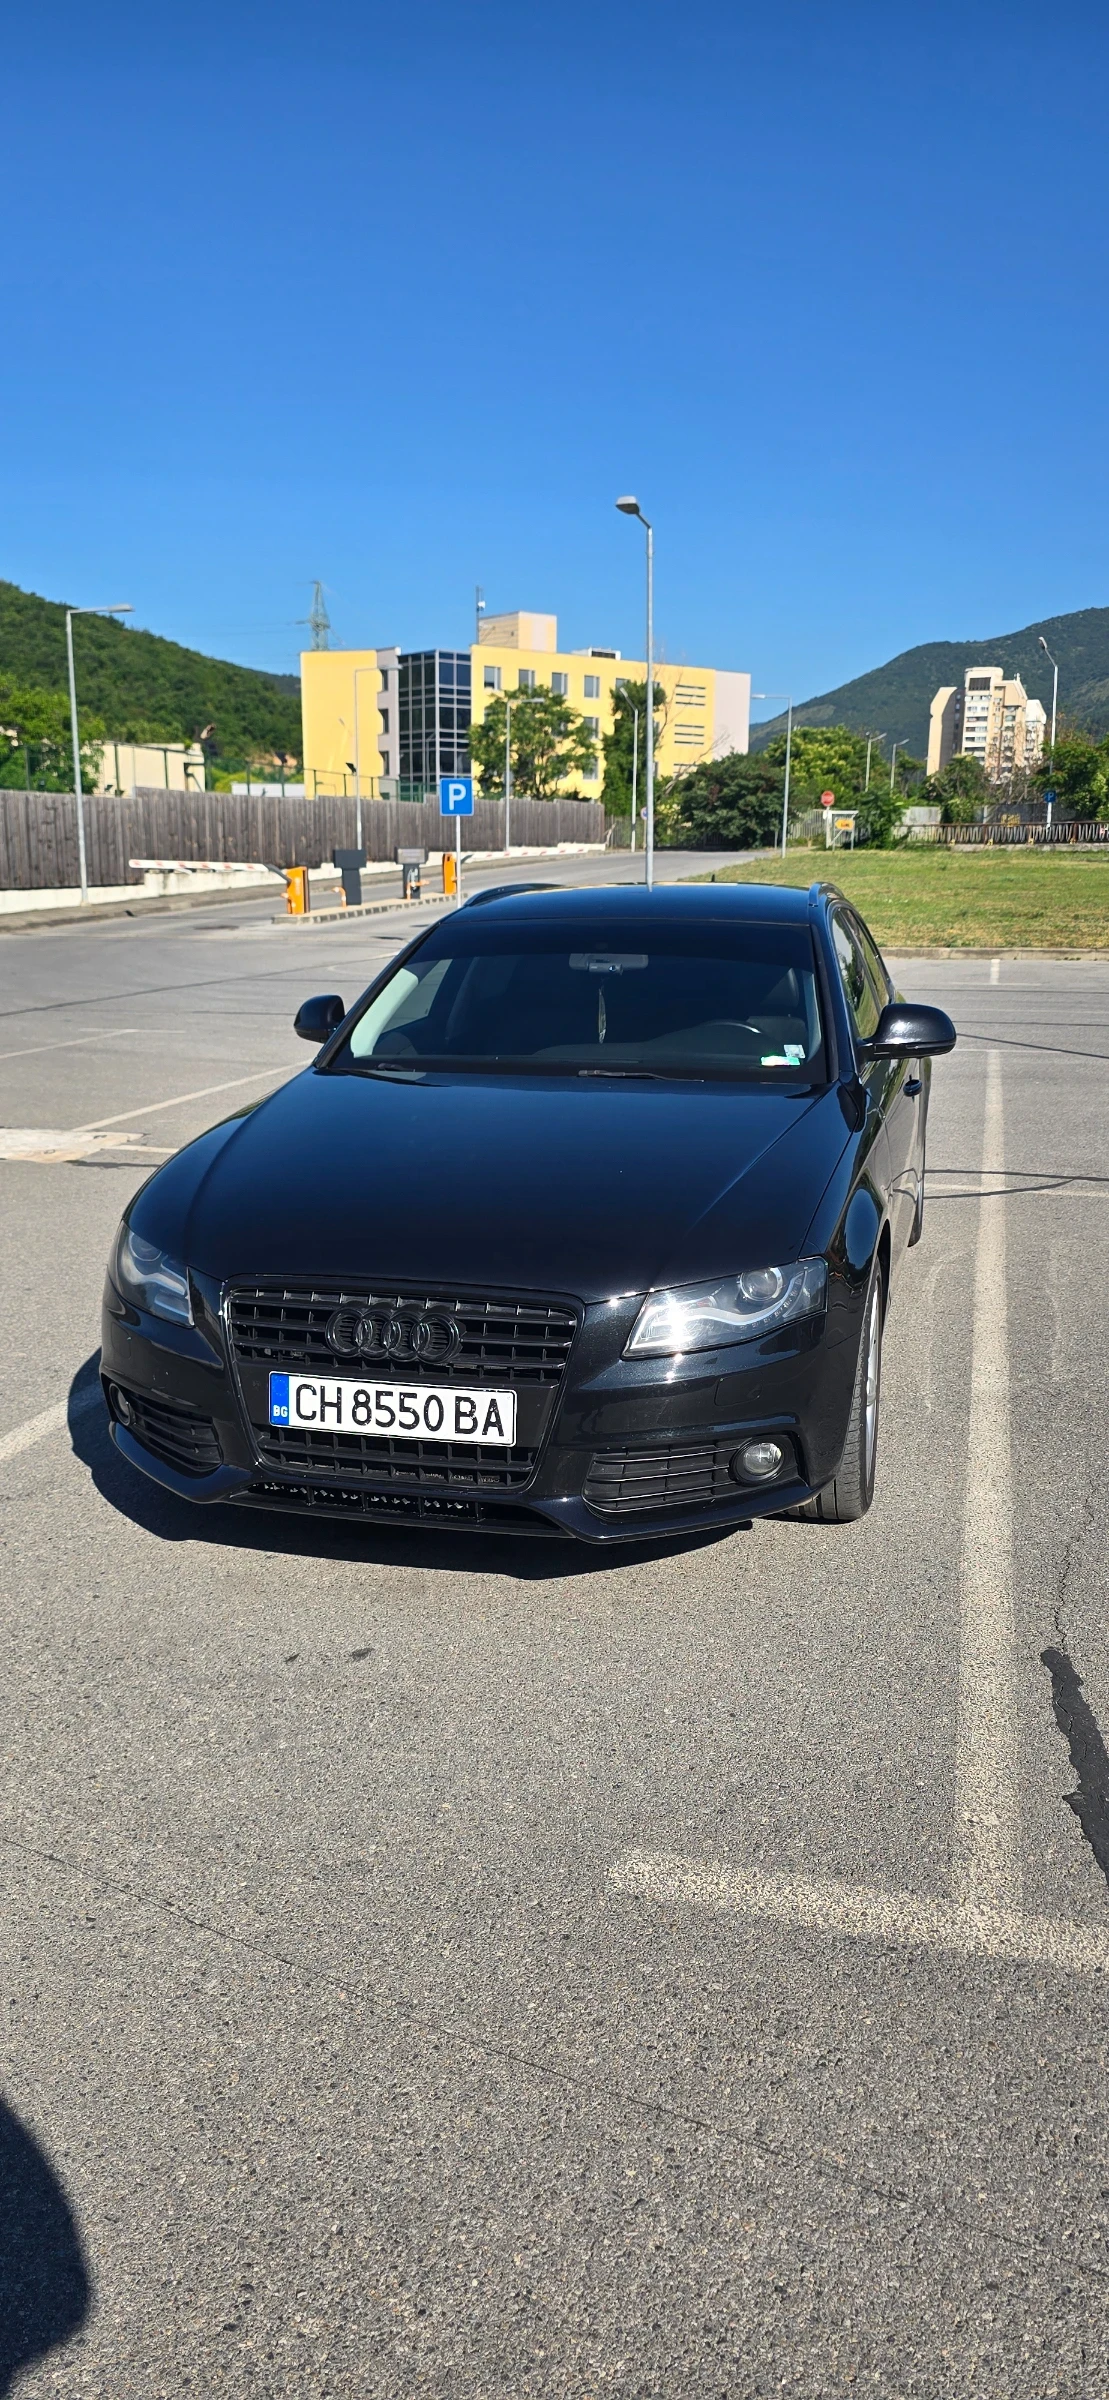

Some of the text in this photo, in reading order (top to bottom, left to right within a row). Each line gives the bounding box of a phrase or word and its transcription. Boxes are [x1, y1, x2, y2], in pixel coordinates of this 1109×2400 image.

[448, 783, 467, 811] P
[273, 1404, 288, 1418] BG
[295, 1383, 505, 1437] CH 8550 BA
